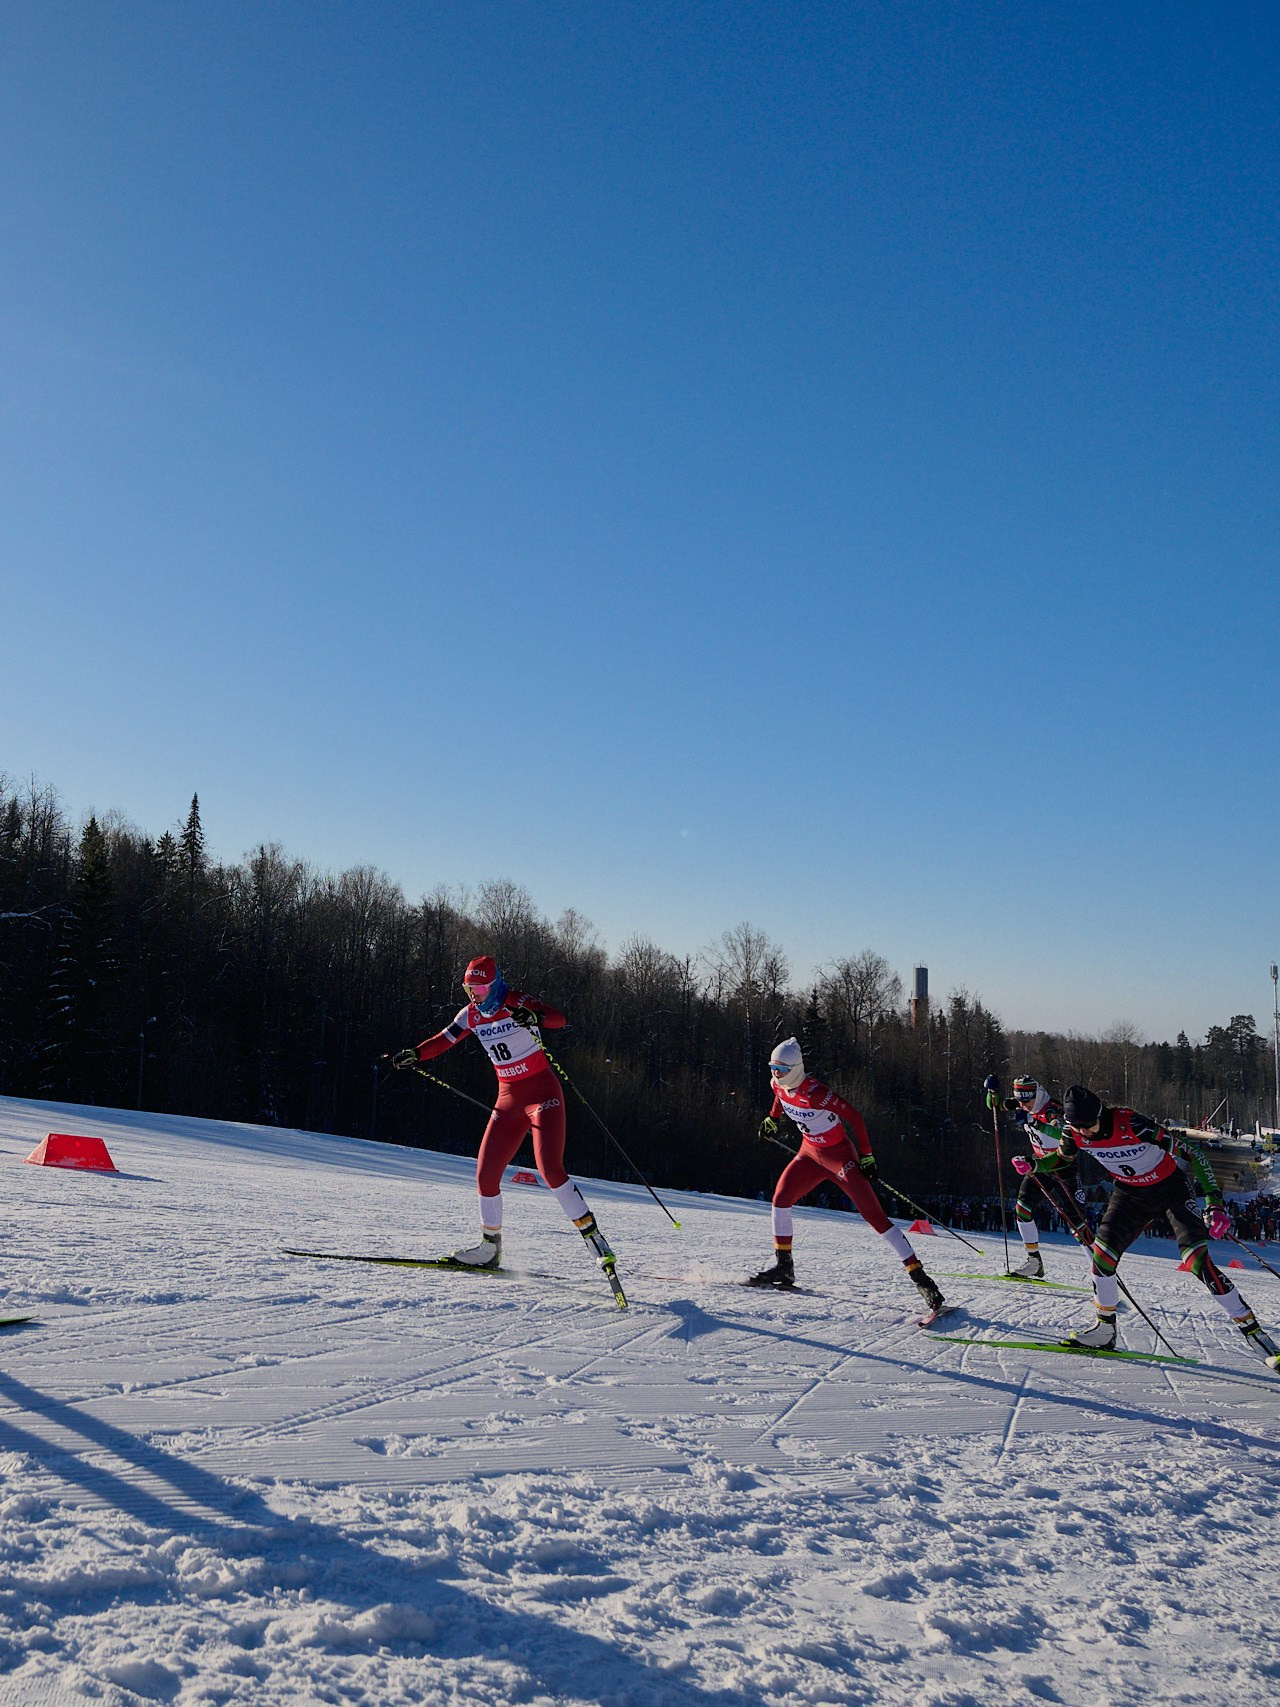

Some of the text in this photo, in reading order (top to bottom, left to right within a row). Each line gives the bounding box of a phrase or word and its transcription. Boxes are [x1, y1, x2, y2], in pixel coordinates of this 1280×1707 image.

[490, 1042, 512, 1062] 18
[1096, 1145, 1147, 1159] ФОСАГРО
[1175, 1138, 1218, 1187] TATARSTAN
